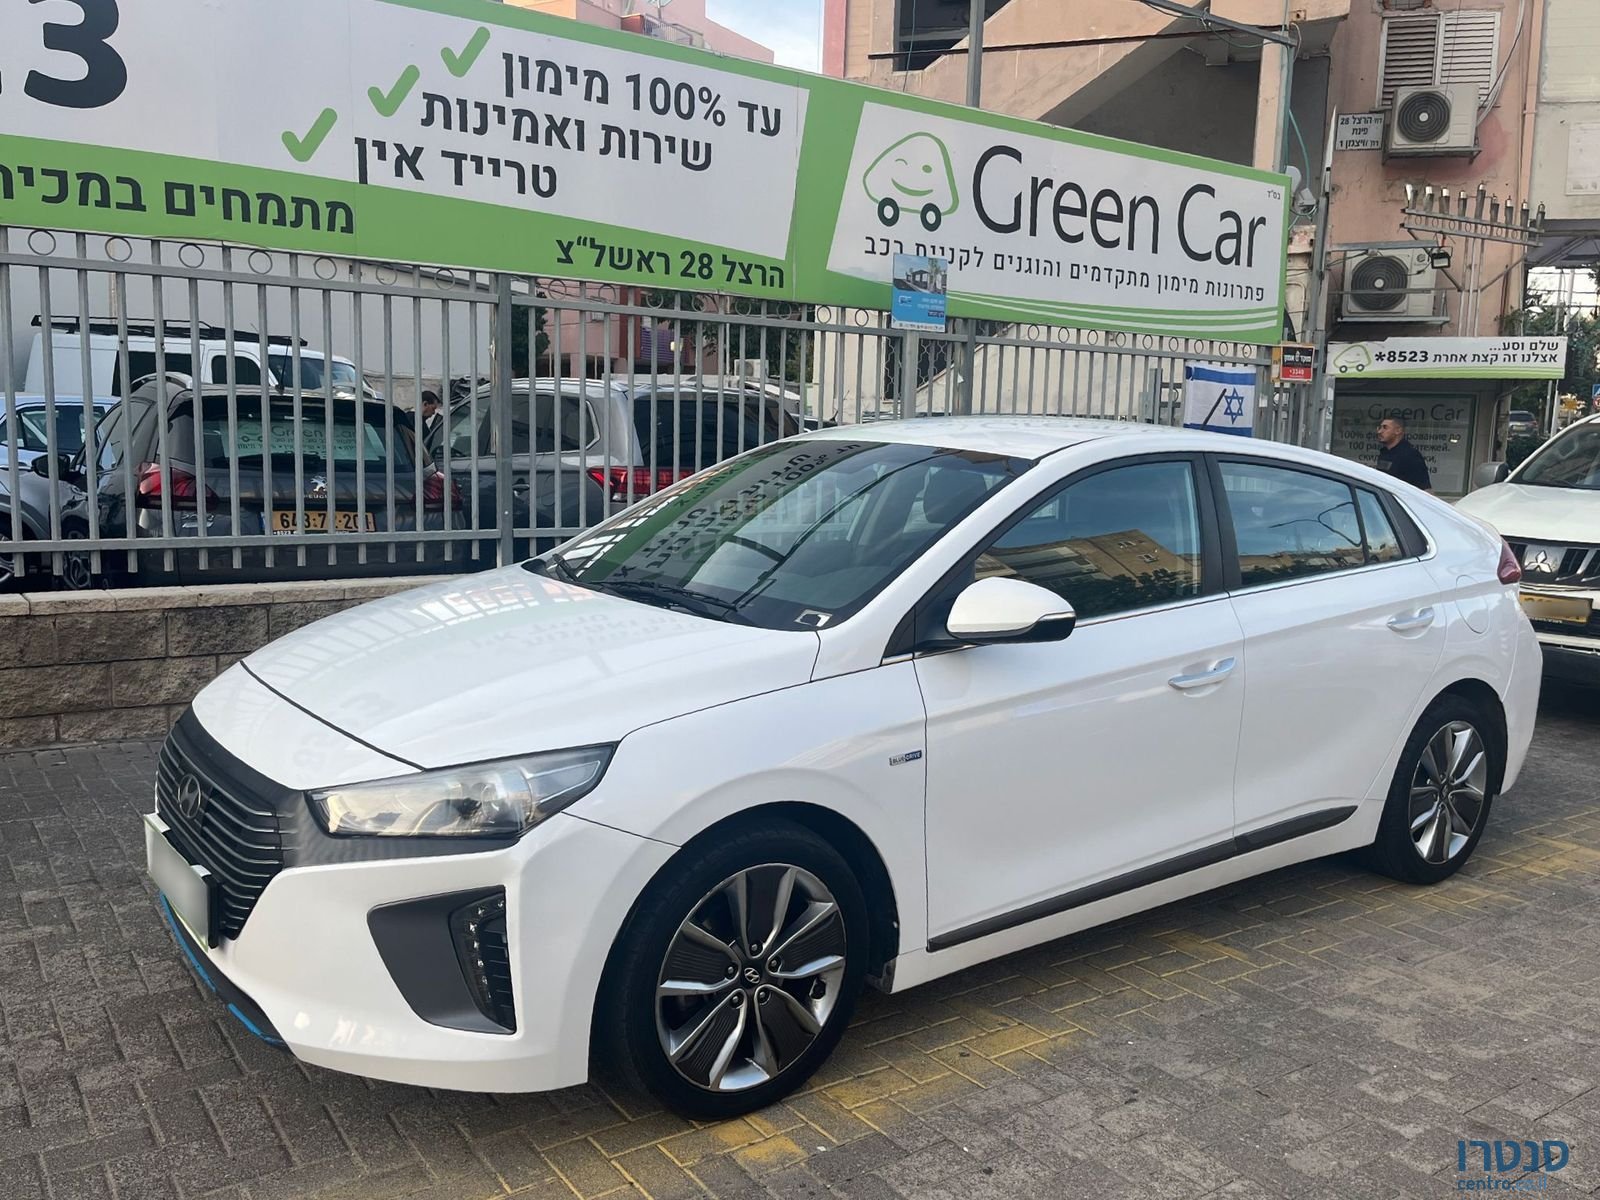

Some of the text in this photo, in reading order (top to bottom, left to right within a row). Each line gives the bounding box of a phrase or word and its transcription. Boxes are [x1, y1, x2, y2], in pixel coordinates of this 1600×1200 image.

[503, 52, 781, 137] עד 100% מימון
[421, 92, 711, 171] שירות ואמינות
[1352, 127, 1368, 135] פינת
[354, 137, 557, 198] טרייד אין
[165, 182, 354, 234] מתמחים
[973, 145, 1266, 268] Green Car
[864, 236, 904, 256] רכב
[680, 251, 713, 280] 28
[722, 255, 784, 288] הרצל
[994, 254, 1060, 279] והוגנים
[1070, 265, 1149, 289] מתקדמים
[1157, 274, 1199, 294] מימון
[1205, 280, 1264, 302] פתרונות
[1530, 340, 1559, 351] שלם
[1433, 352, 1468, 363] אחרת
[1471, 352, 1498, 365] קצת
[1503, 353, 1517, 363] זה
[1522, 352, 1558, 363] אצלנו
[1368, 403, 1465, 420] Green Car
[1340, 431, 1363, 440] 100%
